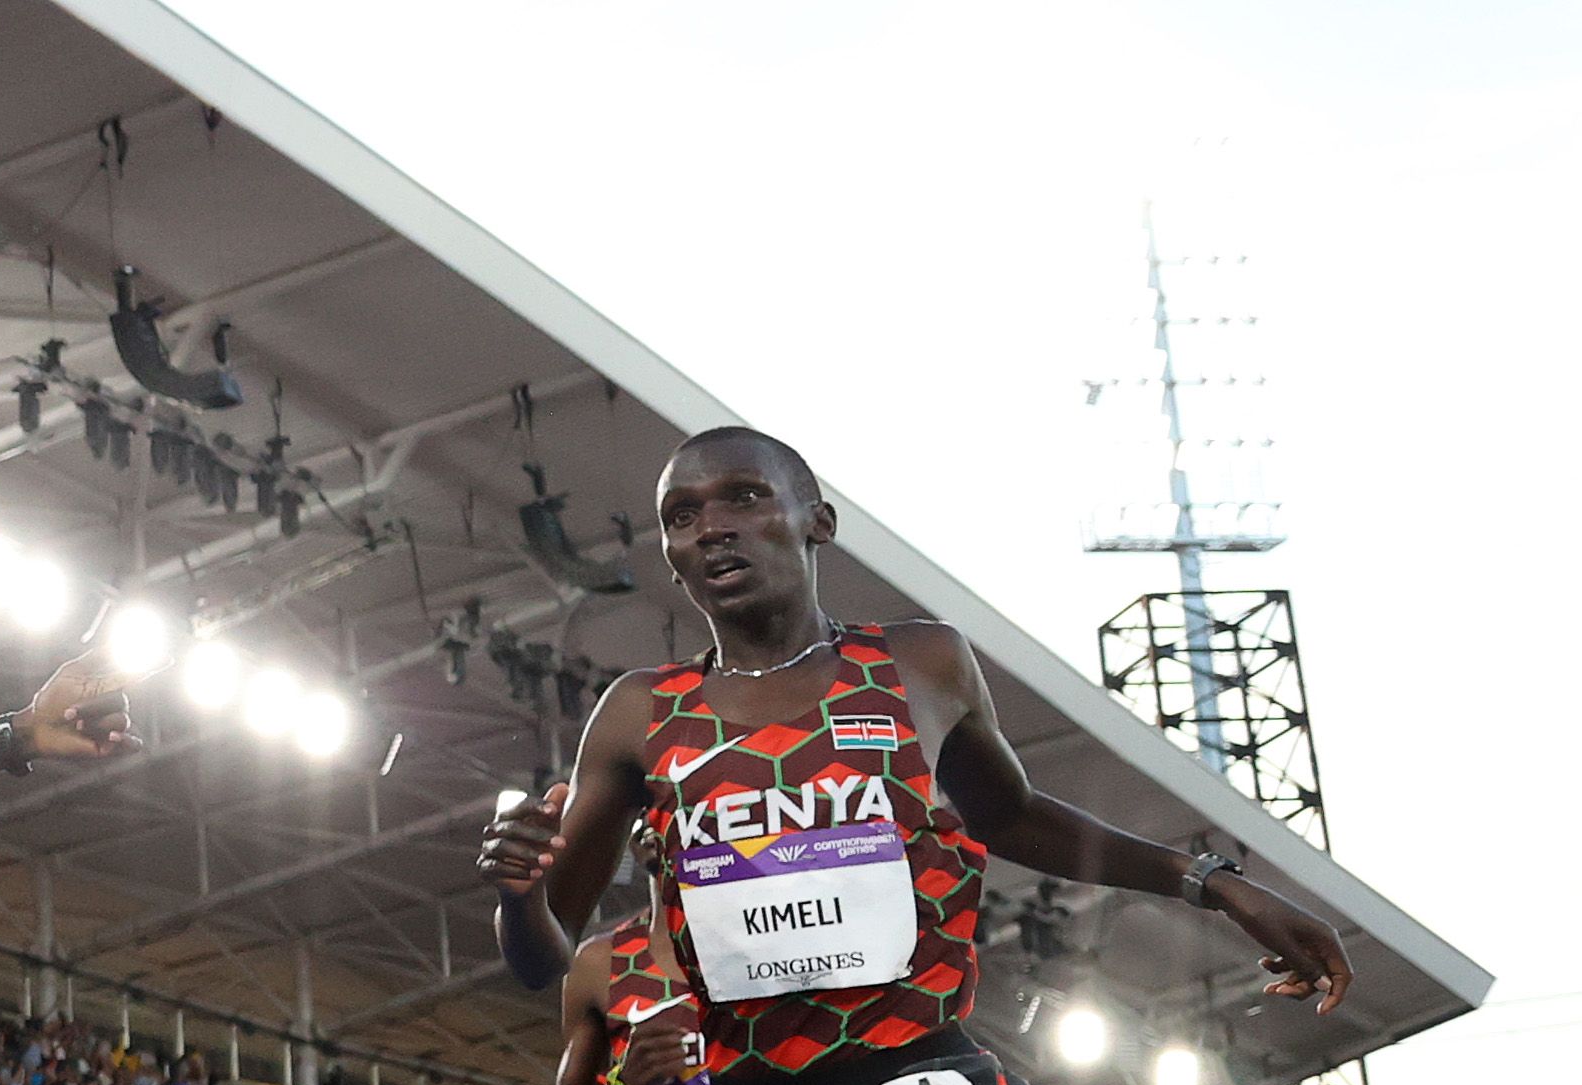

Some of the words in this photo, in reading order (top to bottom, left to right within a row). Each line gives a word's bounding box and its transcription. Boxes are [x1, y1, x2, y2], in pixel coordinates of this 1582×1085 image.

[675, 775, 894, 850] KENYA
[742, 897, 843, 935] KIMELI
[747, 951, 865, 980] LONGINES
